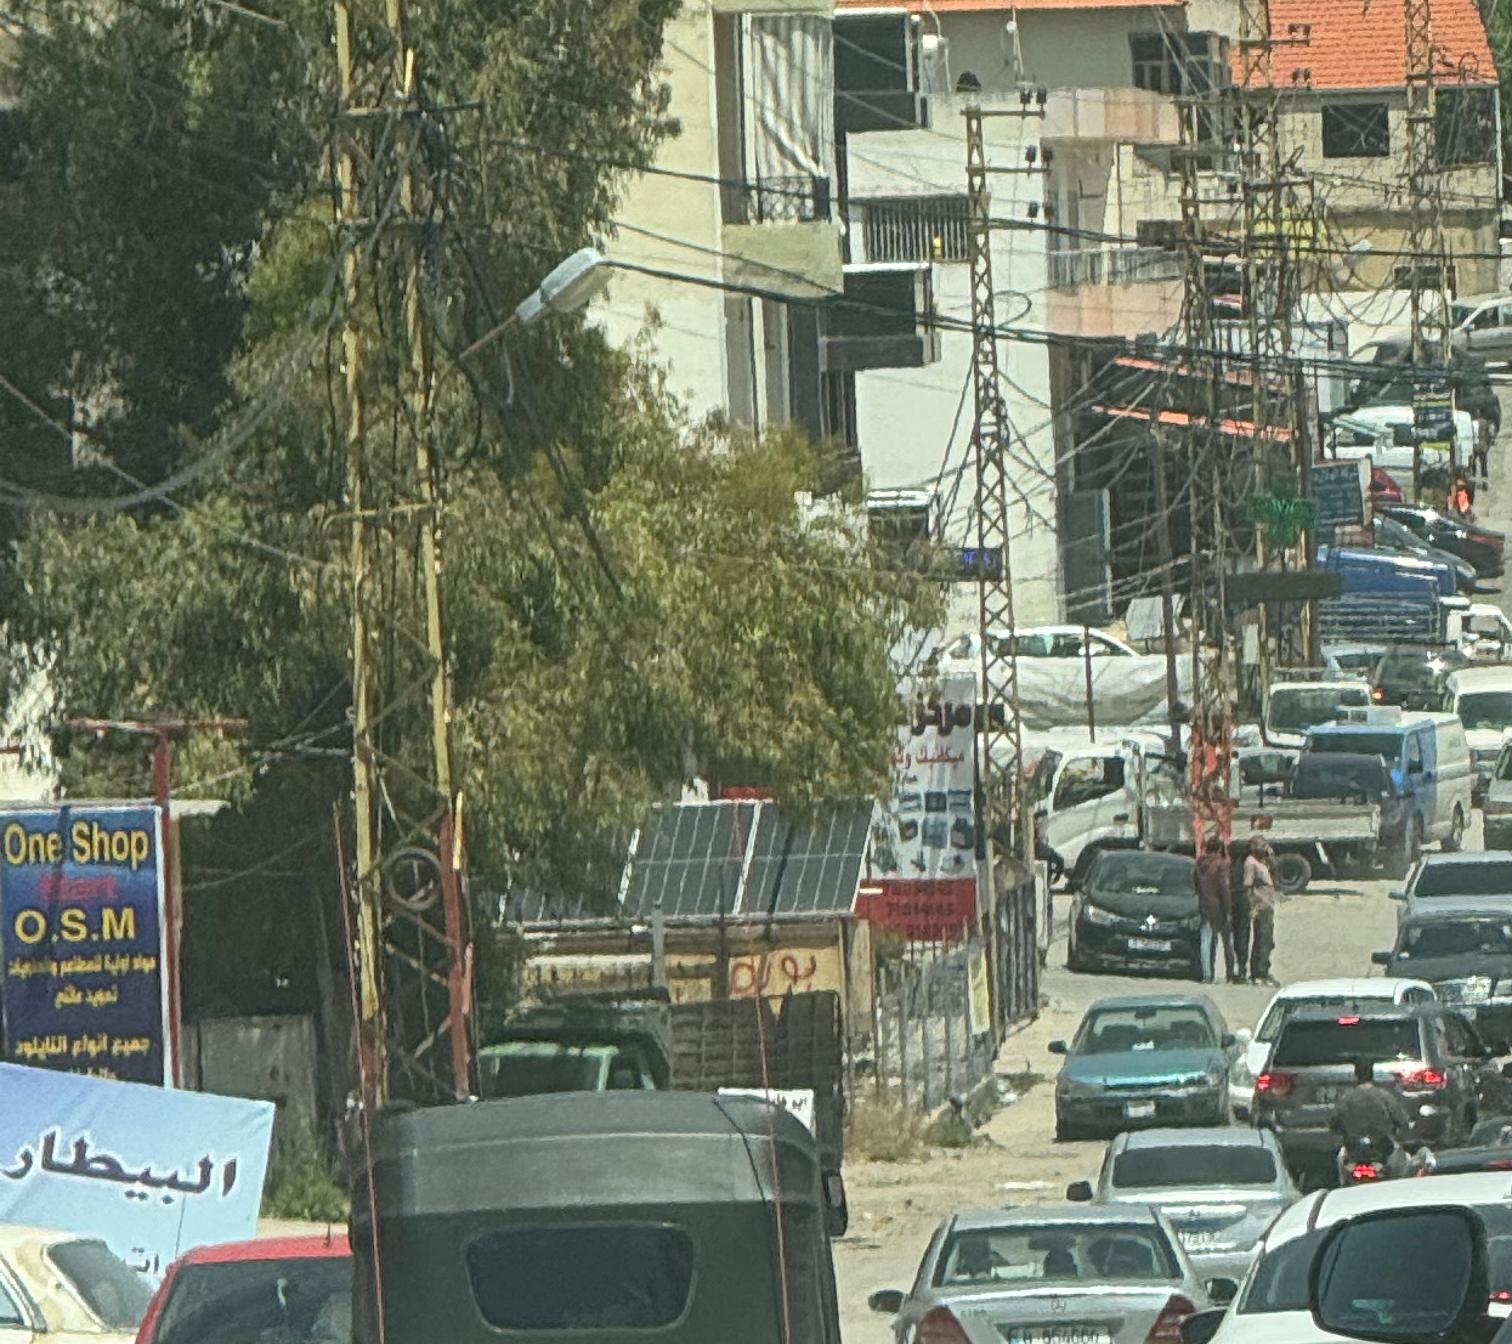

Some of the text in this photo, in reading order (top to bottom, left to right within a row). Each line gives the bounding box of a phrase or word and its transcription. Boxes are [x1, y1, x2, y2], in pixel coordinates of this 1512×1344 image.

[4, 820, 149, 870] One Shop
[14, 907, 137, 944] O.S.M
[1, 1130, 238, 1205] البيطار
